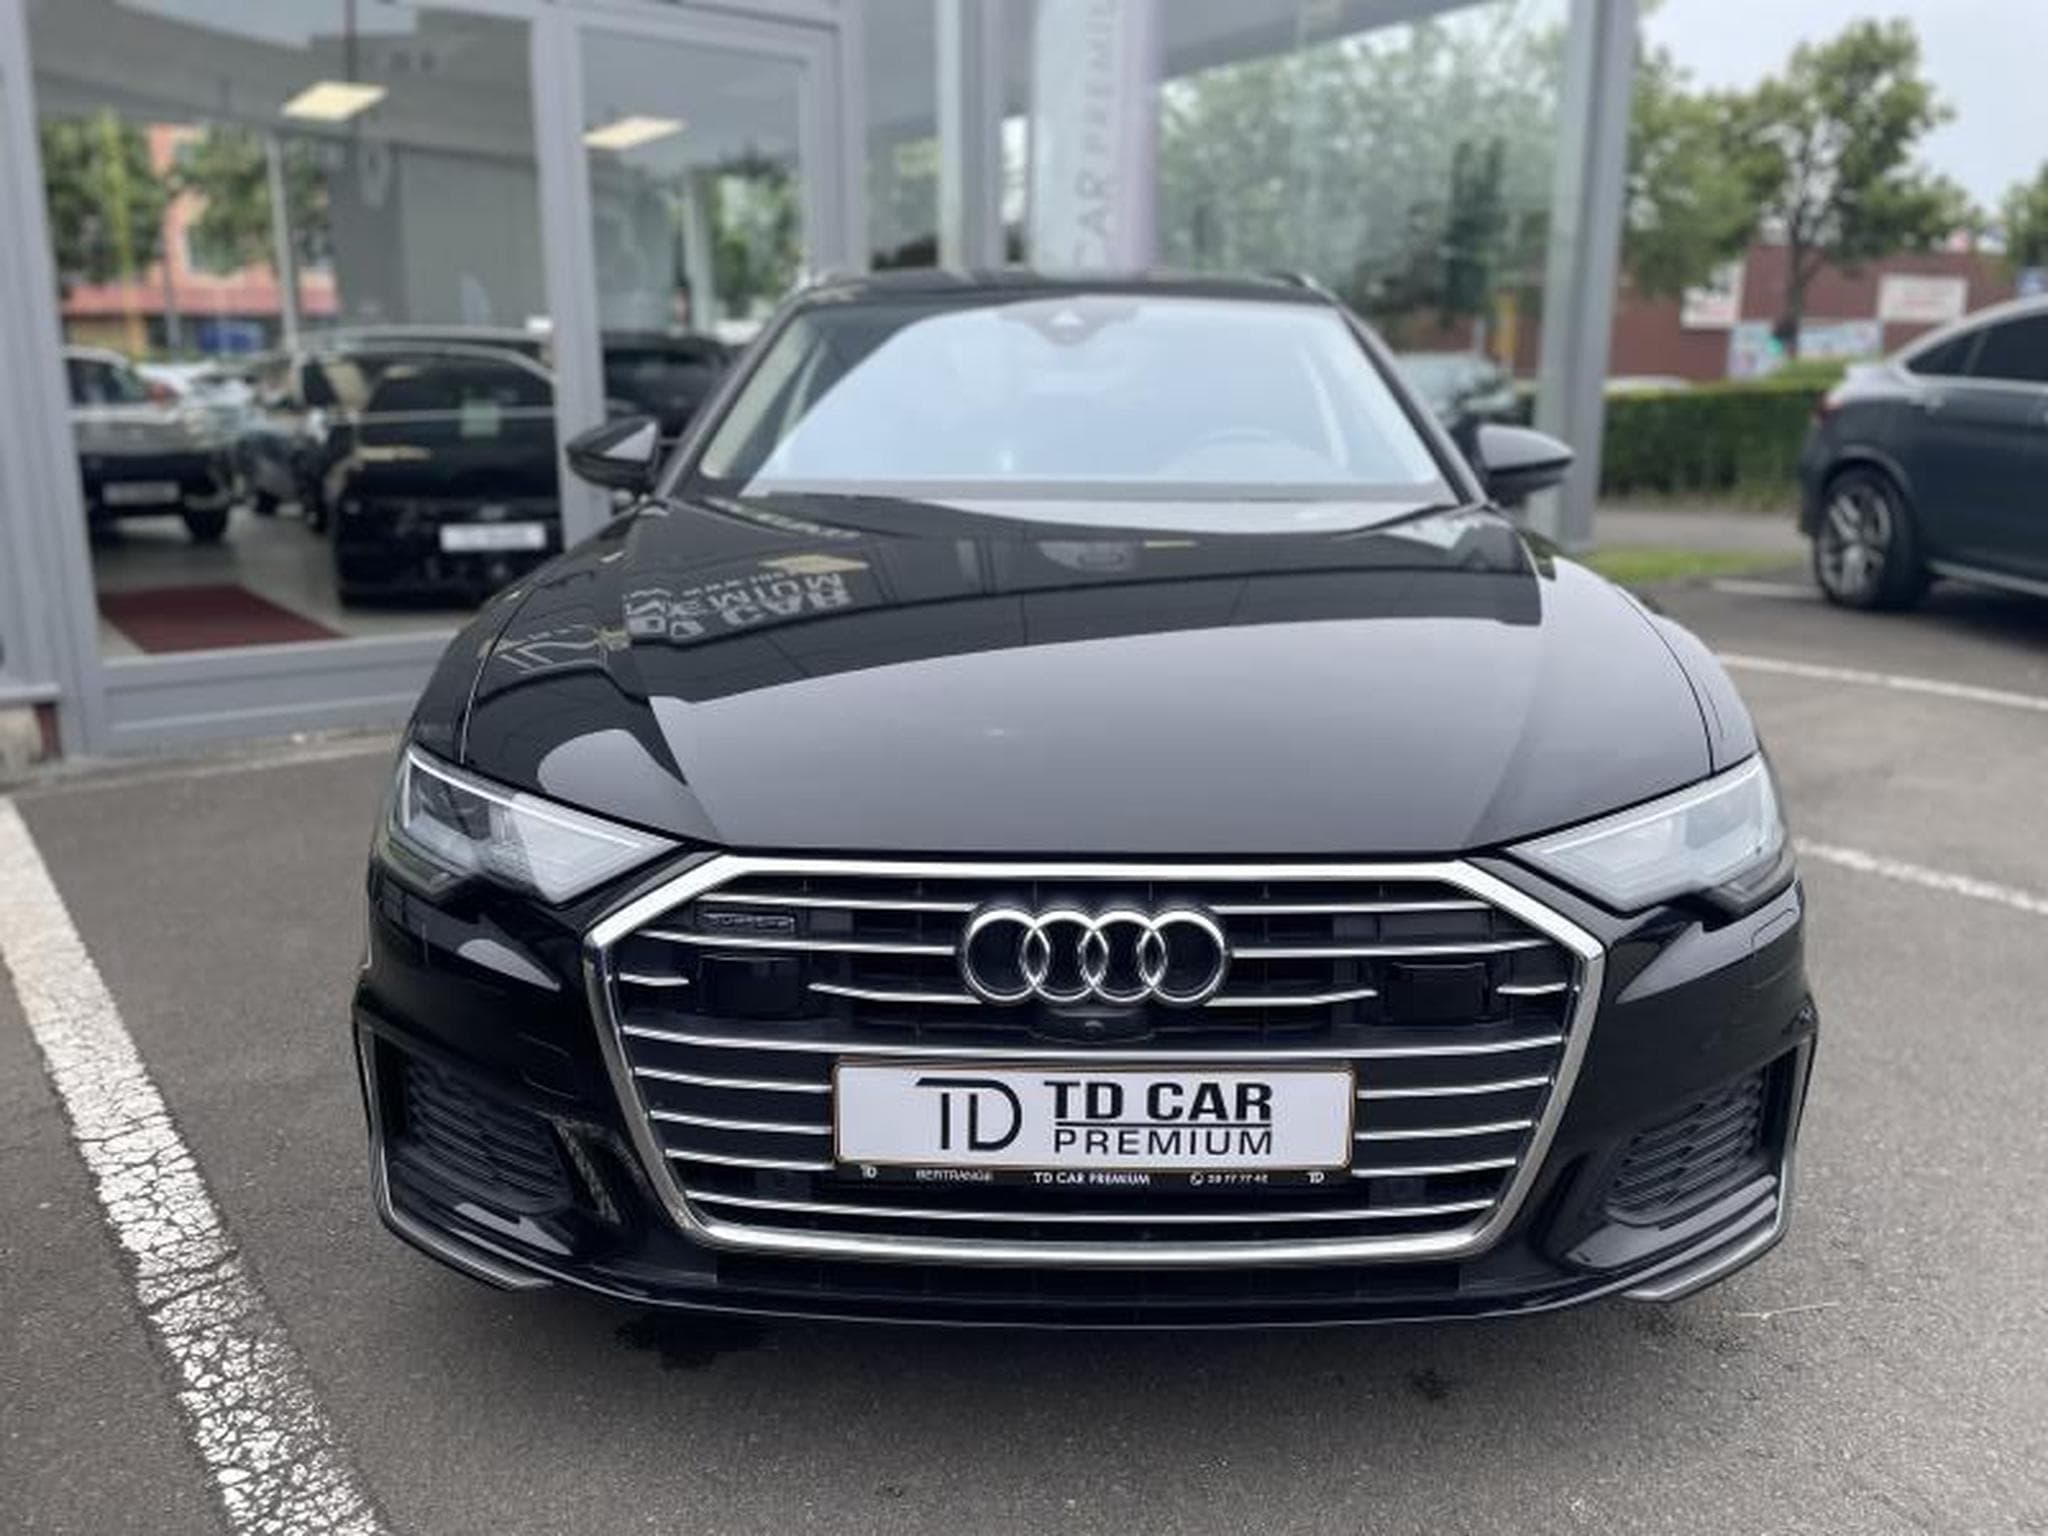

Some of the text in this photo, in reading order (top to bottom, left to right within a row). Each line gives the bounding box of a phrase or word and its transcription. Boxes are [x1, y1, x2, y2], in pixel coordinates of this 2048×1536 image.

[915, 1077, 1023, 1151] TD
[1044, 1080, 1272, 1121] TD CAR
[1054, 1129, 1272, 1156] PREMIUM
[1033, 1171, 1151, 1186] TD CAR PREMIUM
